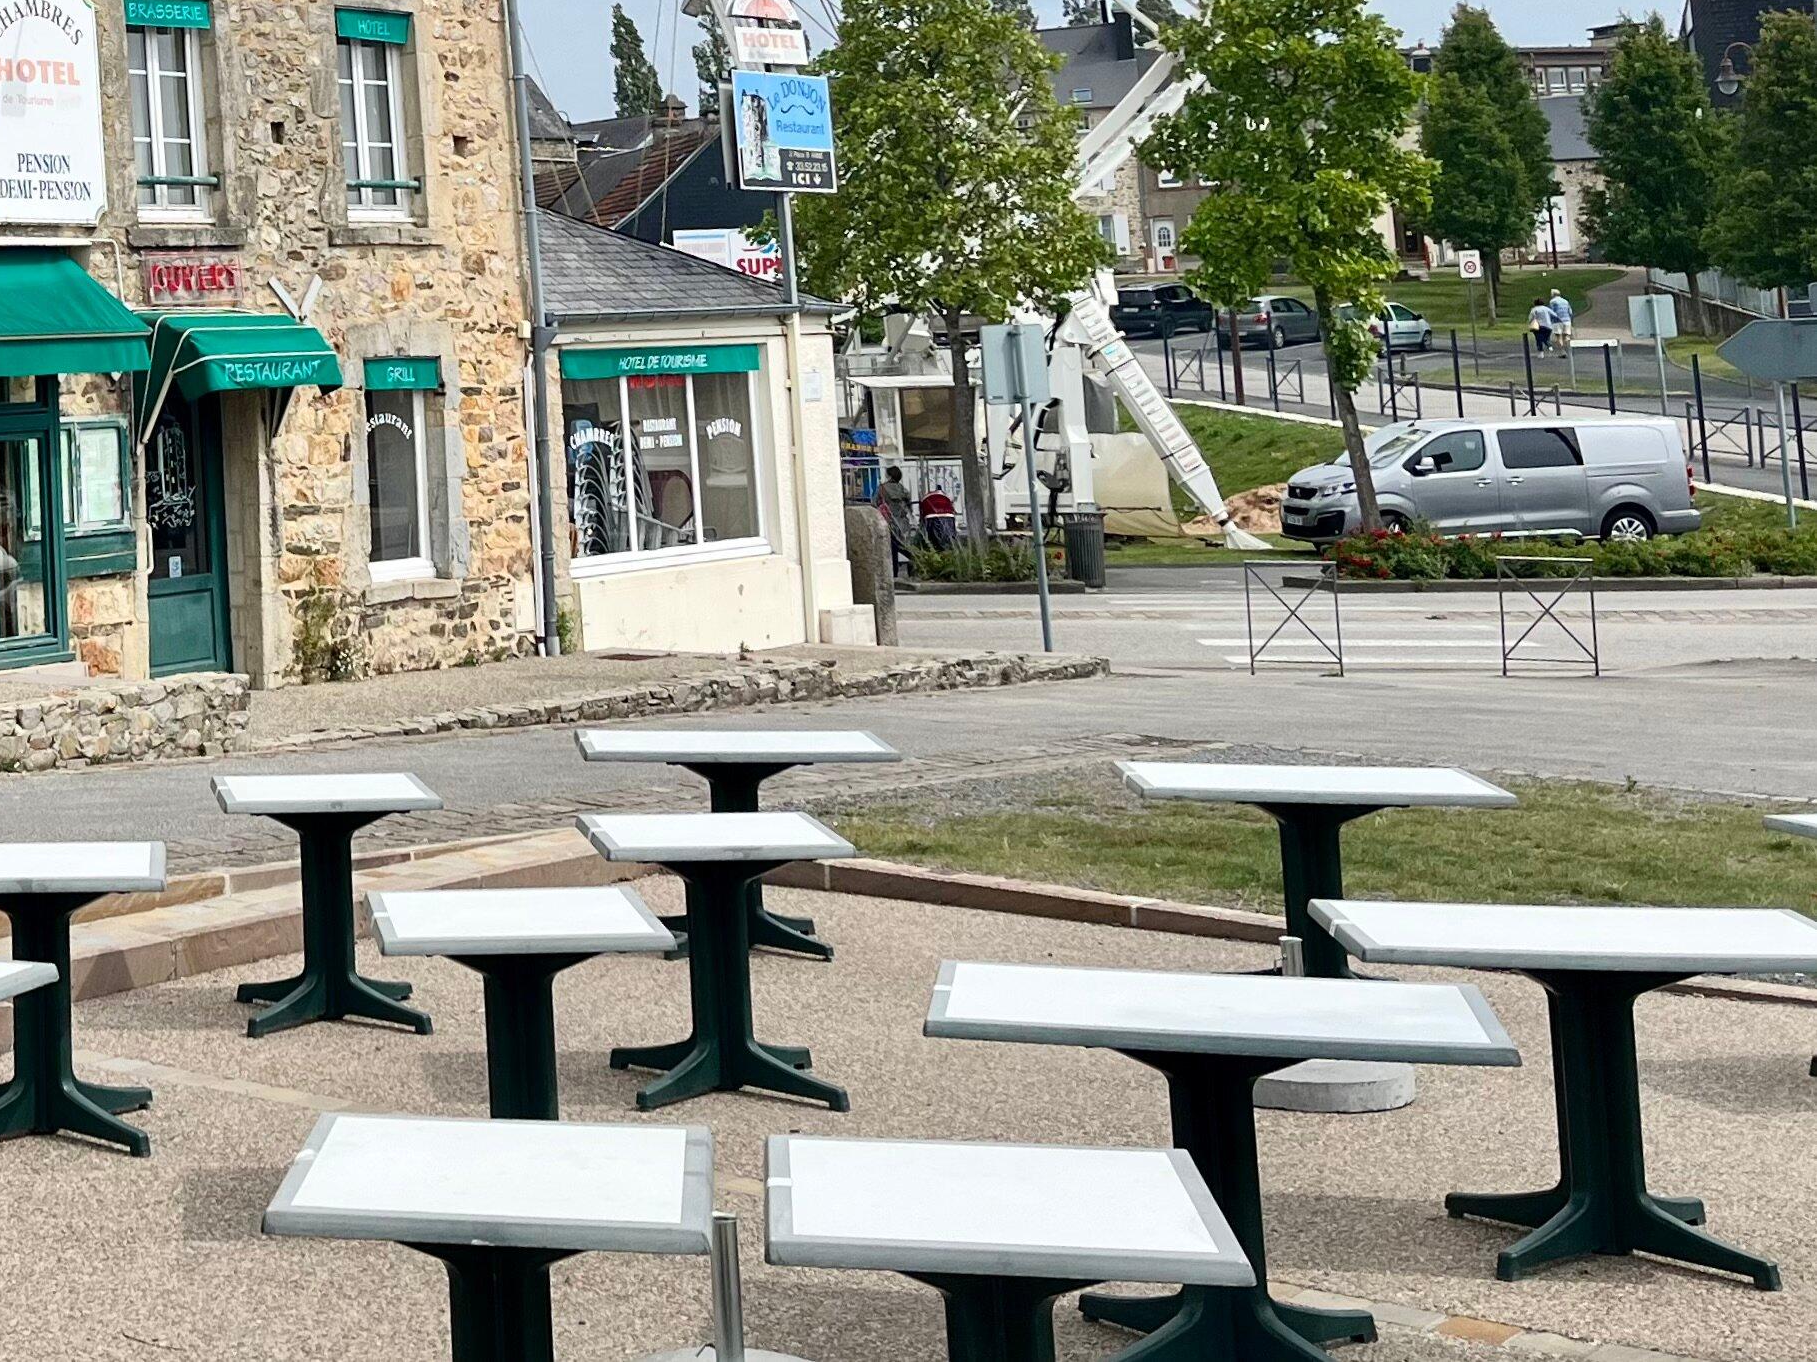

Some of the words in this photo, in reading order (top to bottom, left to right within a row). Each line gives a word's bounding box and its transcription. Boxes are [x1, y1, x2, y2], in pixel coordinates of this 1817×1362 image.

[128, 2, 204, 21] BRASSERIE
[358, 19, 391, 36] HOTEL
[743, 33, 799, 50] HOTEL
[781, 79, 826, 114] DONJON
[776, 119, 825, 135] Restaurant
[17, 152, 71, 175] PENSION
[791, 172, 811, 185] ICI
[225, 360, 322, 382] RESTAURANT
[618, 356, 647, 371] HOTEL
[647, 355, 662, 369] DE
[661, 353, 709, 369] TOURISME
[387, 366, 416, 382] GRILL
[366, 412, 413, 439] estaurant
[706, 418, 742, 439] PENSION
